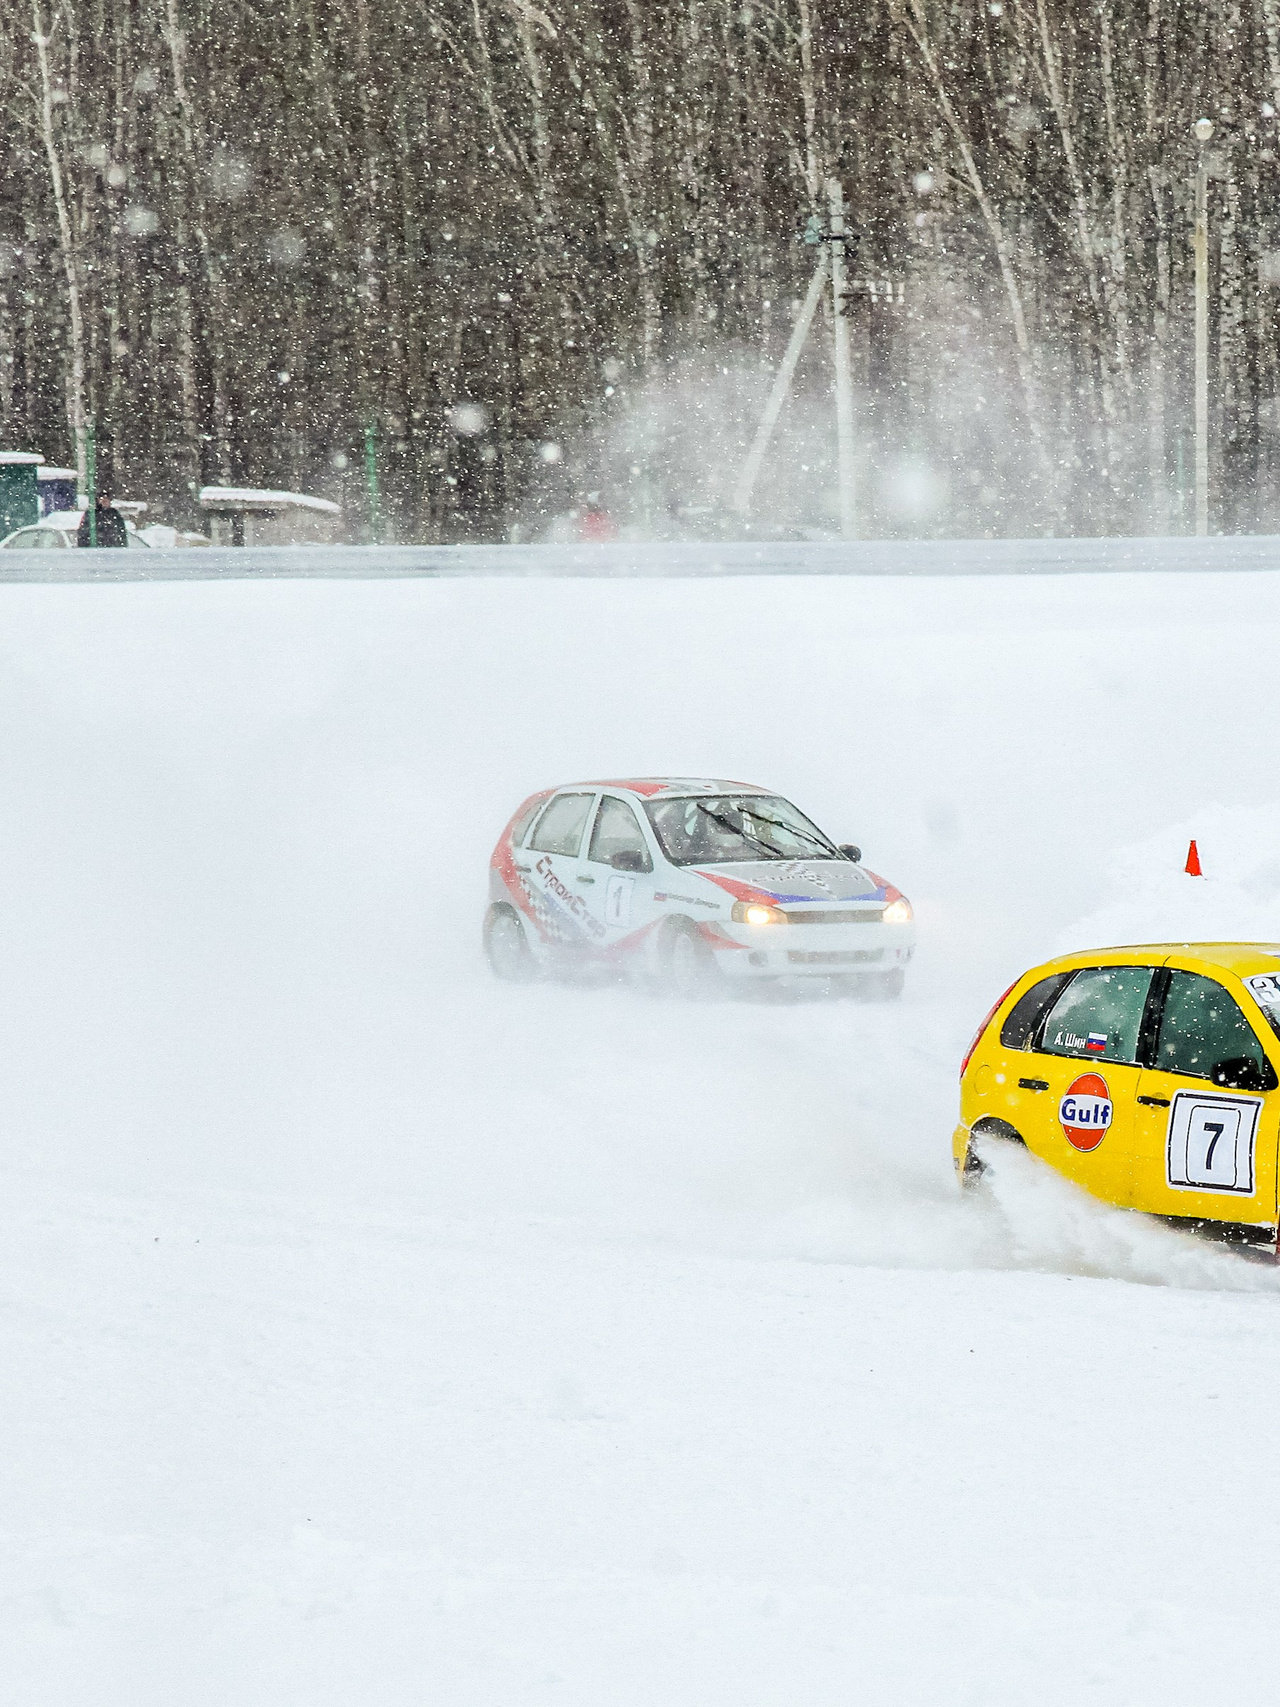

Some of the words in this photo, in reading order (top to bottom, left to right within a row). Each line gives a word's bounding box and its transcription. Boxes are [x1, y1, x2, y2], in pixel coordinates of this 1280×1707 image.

[613, 886, 623, 917] 1
[1065, 1033, 1087, 1049] Шин
[1062, 1098, 1110, 1125] Gulf
[1204, 1122, 1224, 1170] 7
